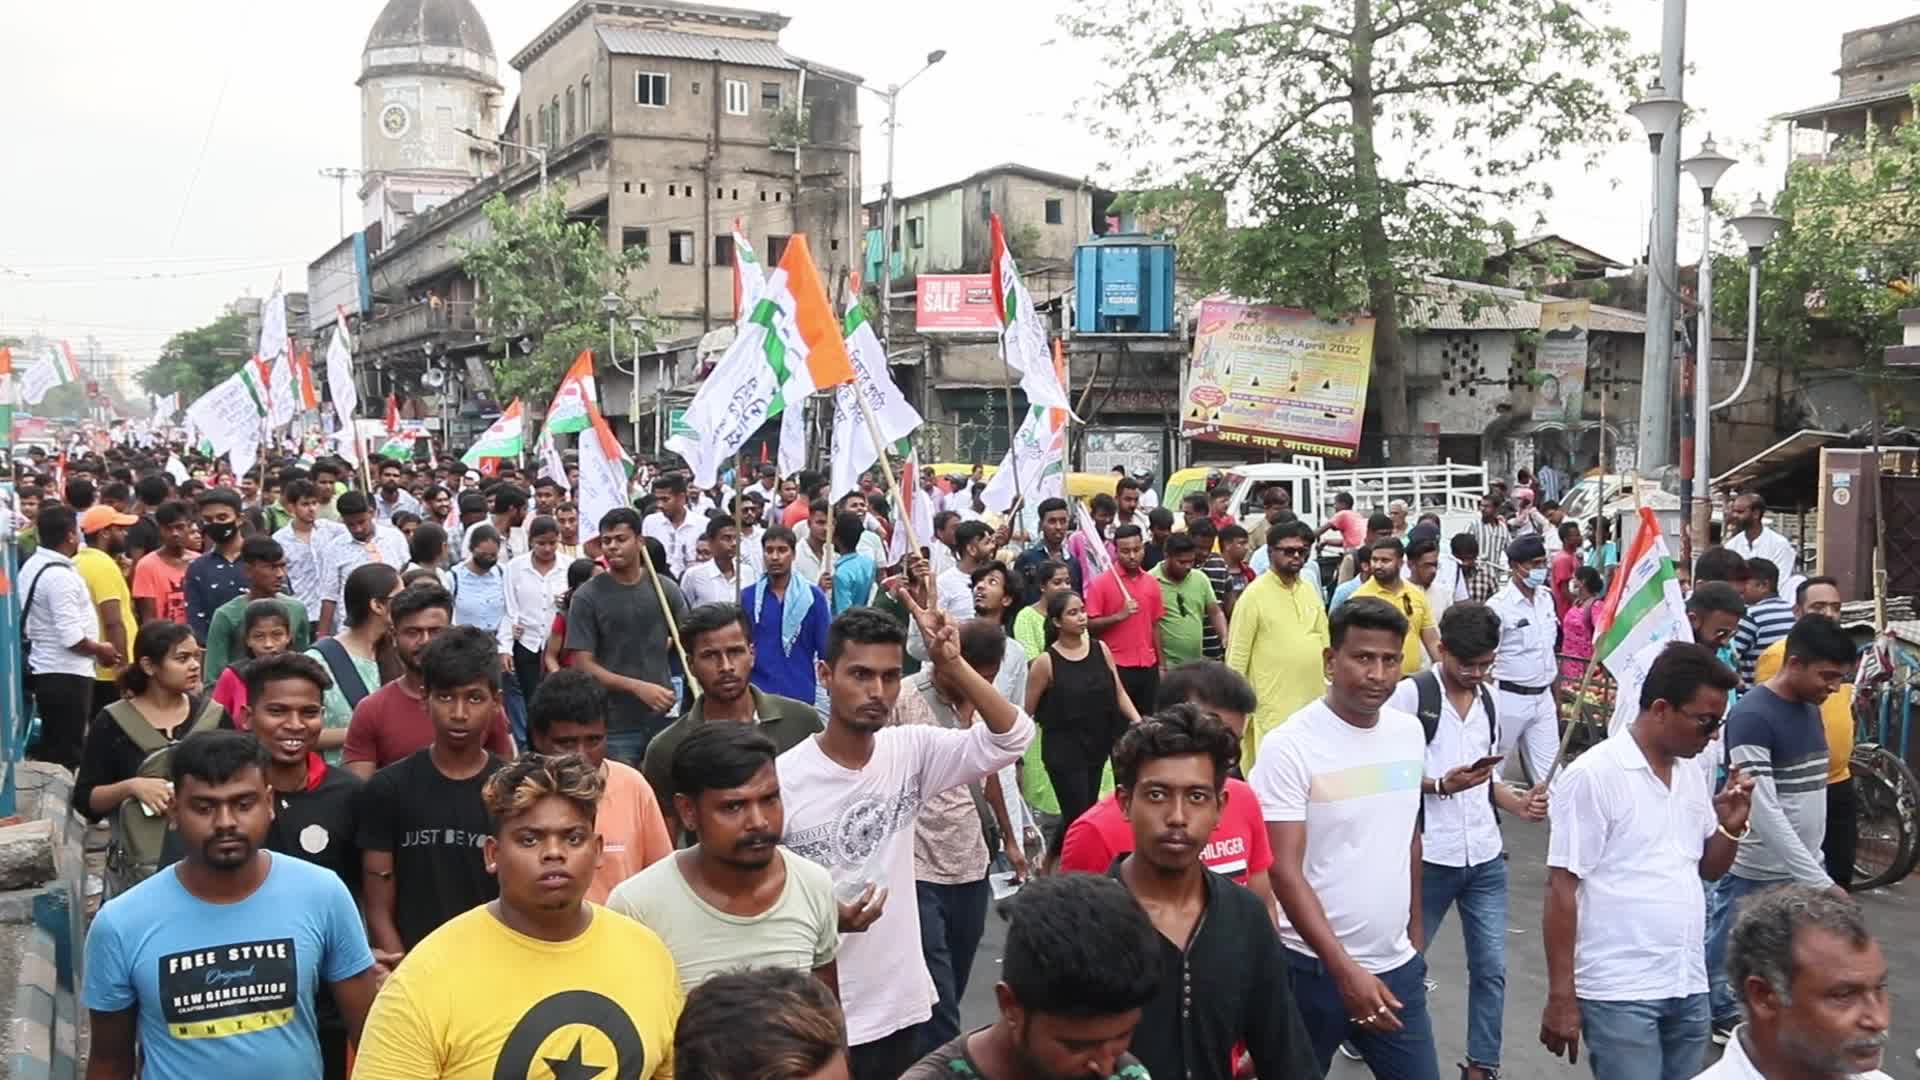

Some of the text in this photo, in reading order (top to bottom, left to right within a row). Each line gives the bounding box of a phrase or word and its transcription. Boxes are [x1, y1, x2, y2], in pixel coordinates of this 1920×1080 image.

[924, 292, 960, 312] SALE
[1265, 335, 1295, 346] 23rd
[1297, 340, 1326, 351] April
[1329, 342, 1361, 355] 2022
[1217, 430, 1249, 444] अमर
[401, 829, 440, 848] JUST
[169, 943, 287, 974] FREE STYLE
[174, 983, 286, 1007] NEW GENERATION
